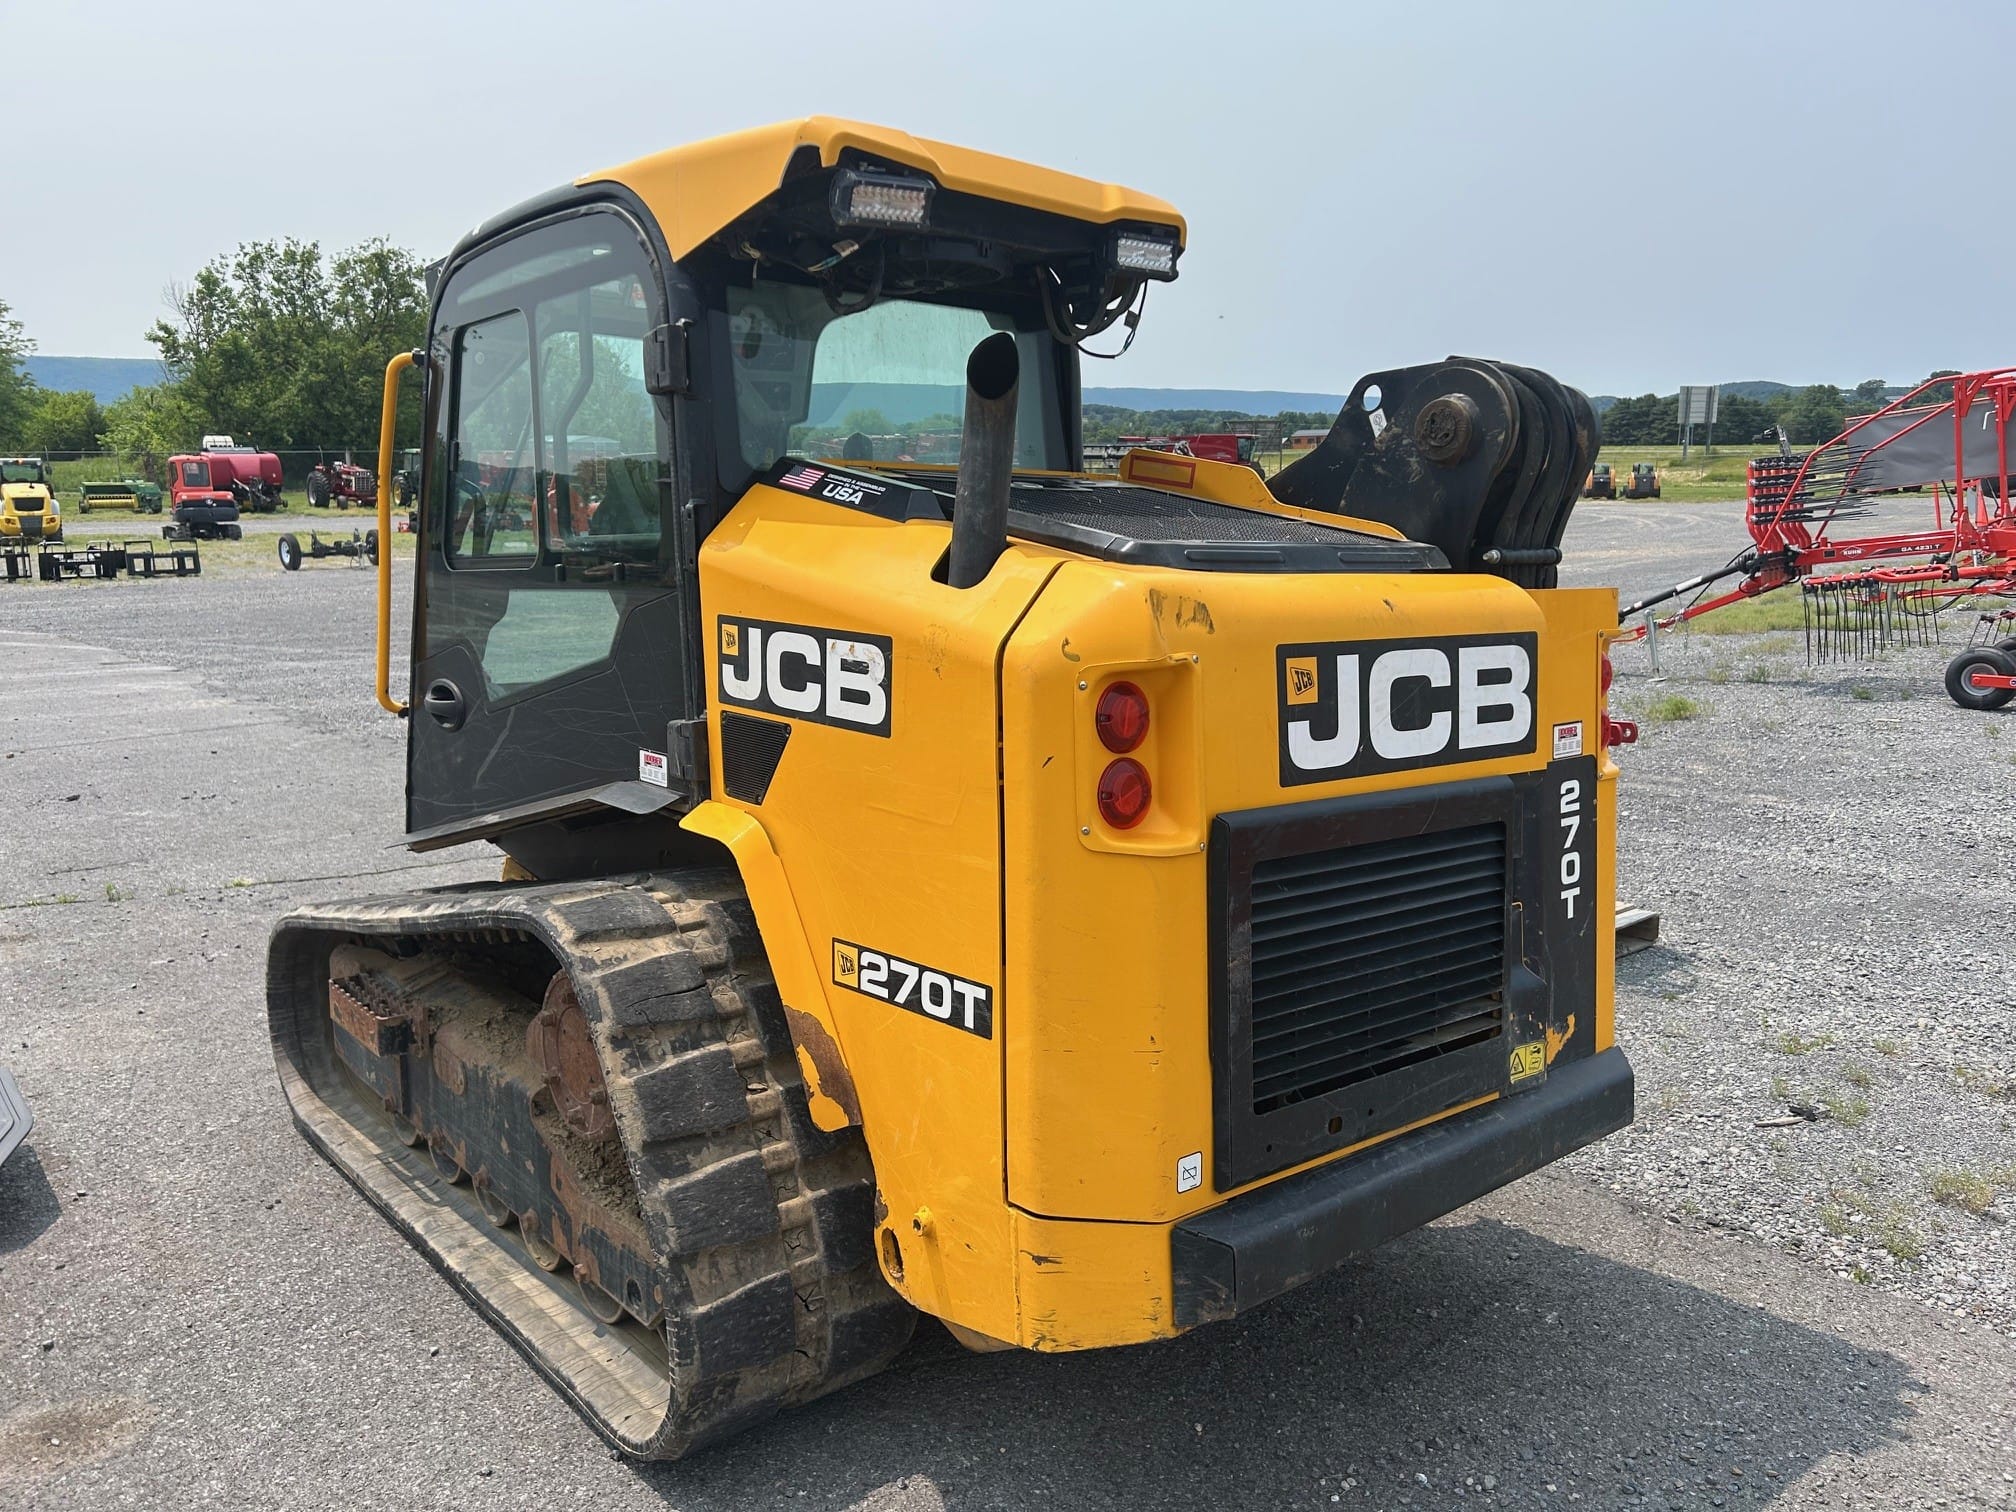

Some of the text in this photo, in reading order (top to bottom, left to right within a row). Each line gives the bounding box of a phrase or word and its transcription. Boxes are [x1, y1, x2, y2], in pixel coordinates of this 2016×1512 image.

[822, 484, 863, 505] USA
[722, 627, 887, 725] JCB
[1287, 644, 1532, 770] JCB
[1294, 669, 1315, 692] JCB
[1560, 779, 1581, 919] 270T
[839, 954, 855, 974] JCB
[860, 951, 987, 1030] 270T
